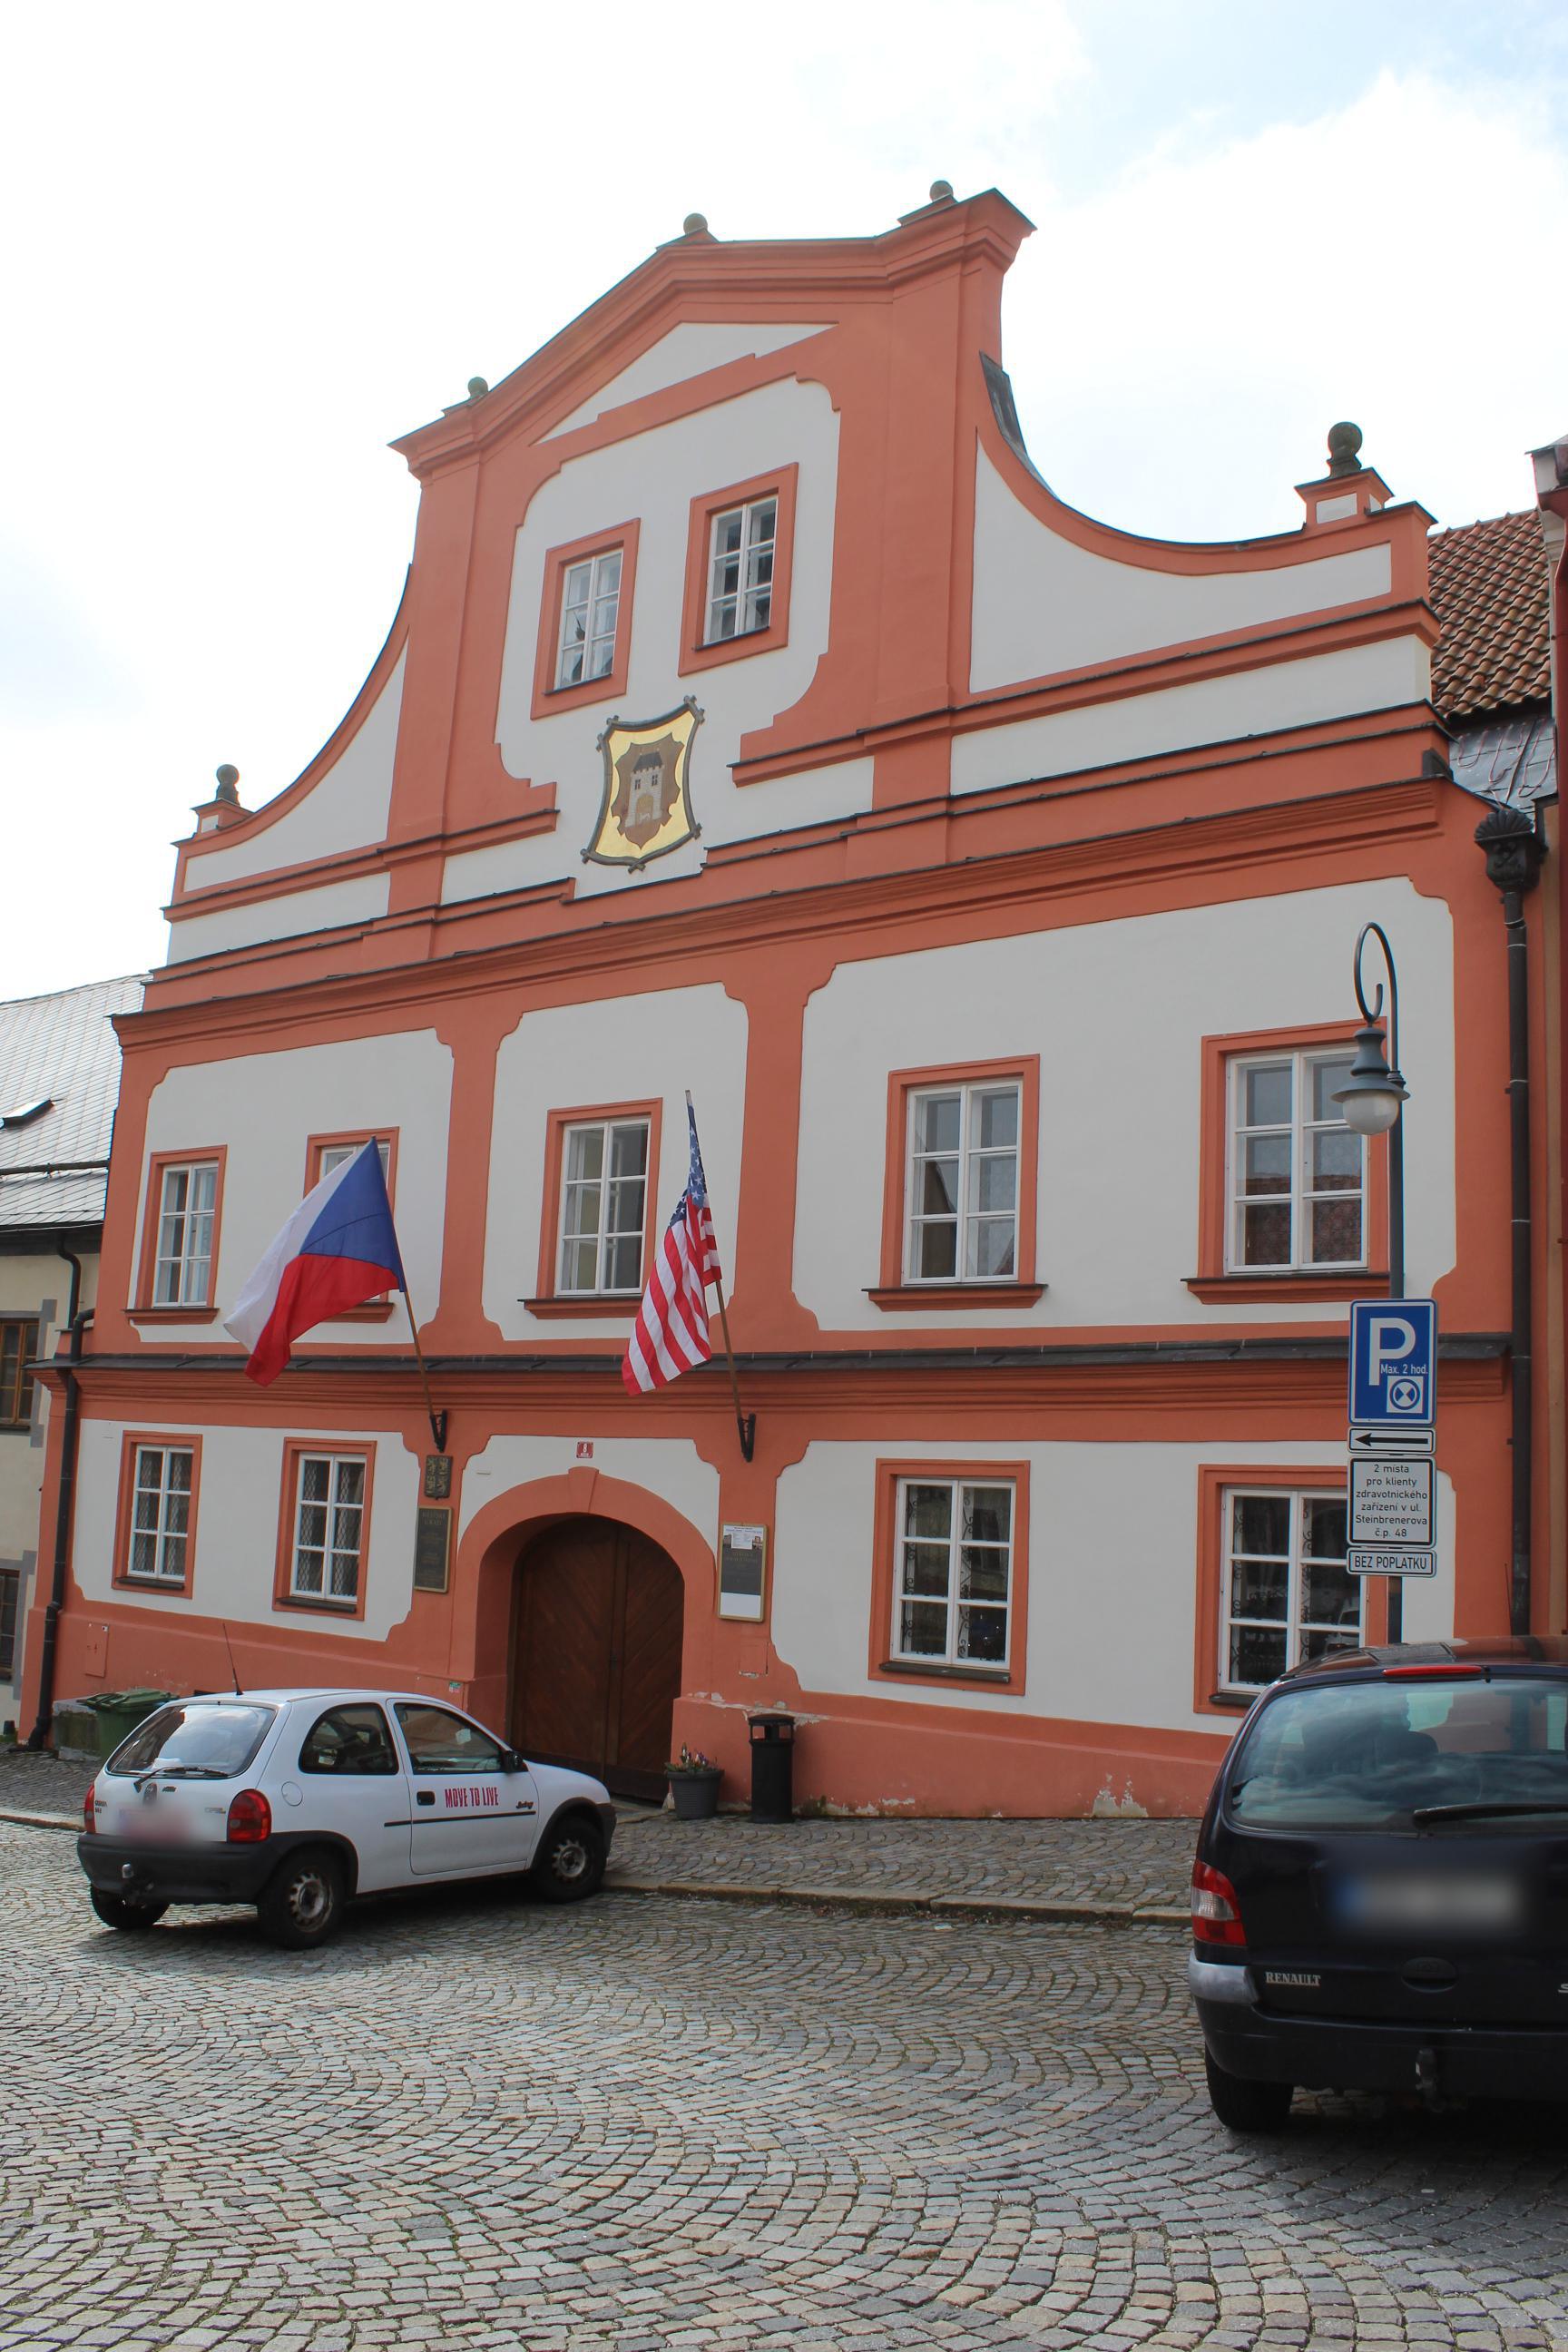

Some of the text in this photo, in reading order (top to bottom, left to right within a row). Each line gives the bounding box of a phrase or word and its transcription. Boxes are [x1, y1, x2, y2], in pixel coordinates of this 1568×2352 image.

[1369, 1318, 1416, 1386] P
[1380, 1364, 1428, 1375] Max. 2 hod.
[1374, 1464, 1379, 1473] 2
[1366, 1477, 1417, 1488] pro klienty
[1356, 1489, 1427, 1499] zdravotnického
[1361, 1502, 1397, 1511] zařízení
[1410, 1503, 1422, 1512] ul.
[1356, 1514, 1427, 1525] Steinbrenerova
[1395, 1528, 1407, 1537] 48
[1354, 1555, 1427, 1570] BEZ POPLATKU
[444, 1788, 469, 1808] MOVE
[469, 1787, 481, 1807] TO
[482, 1786, 499, 1806] LIVE
[1265, 1971, 1321, 1987] RENAULT
